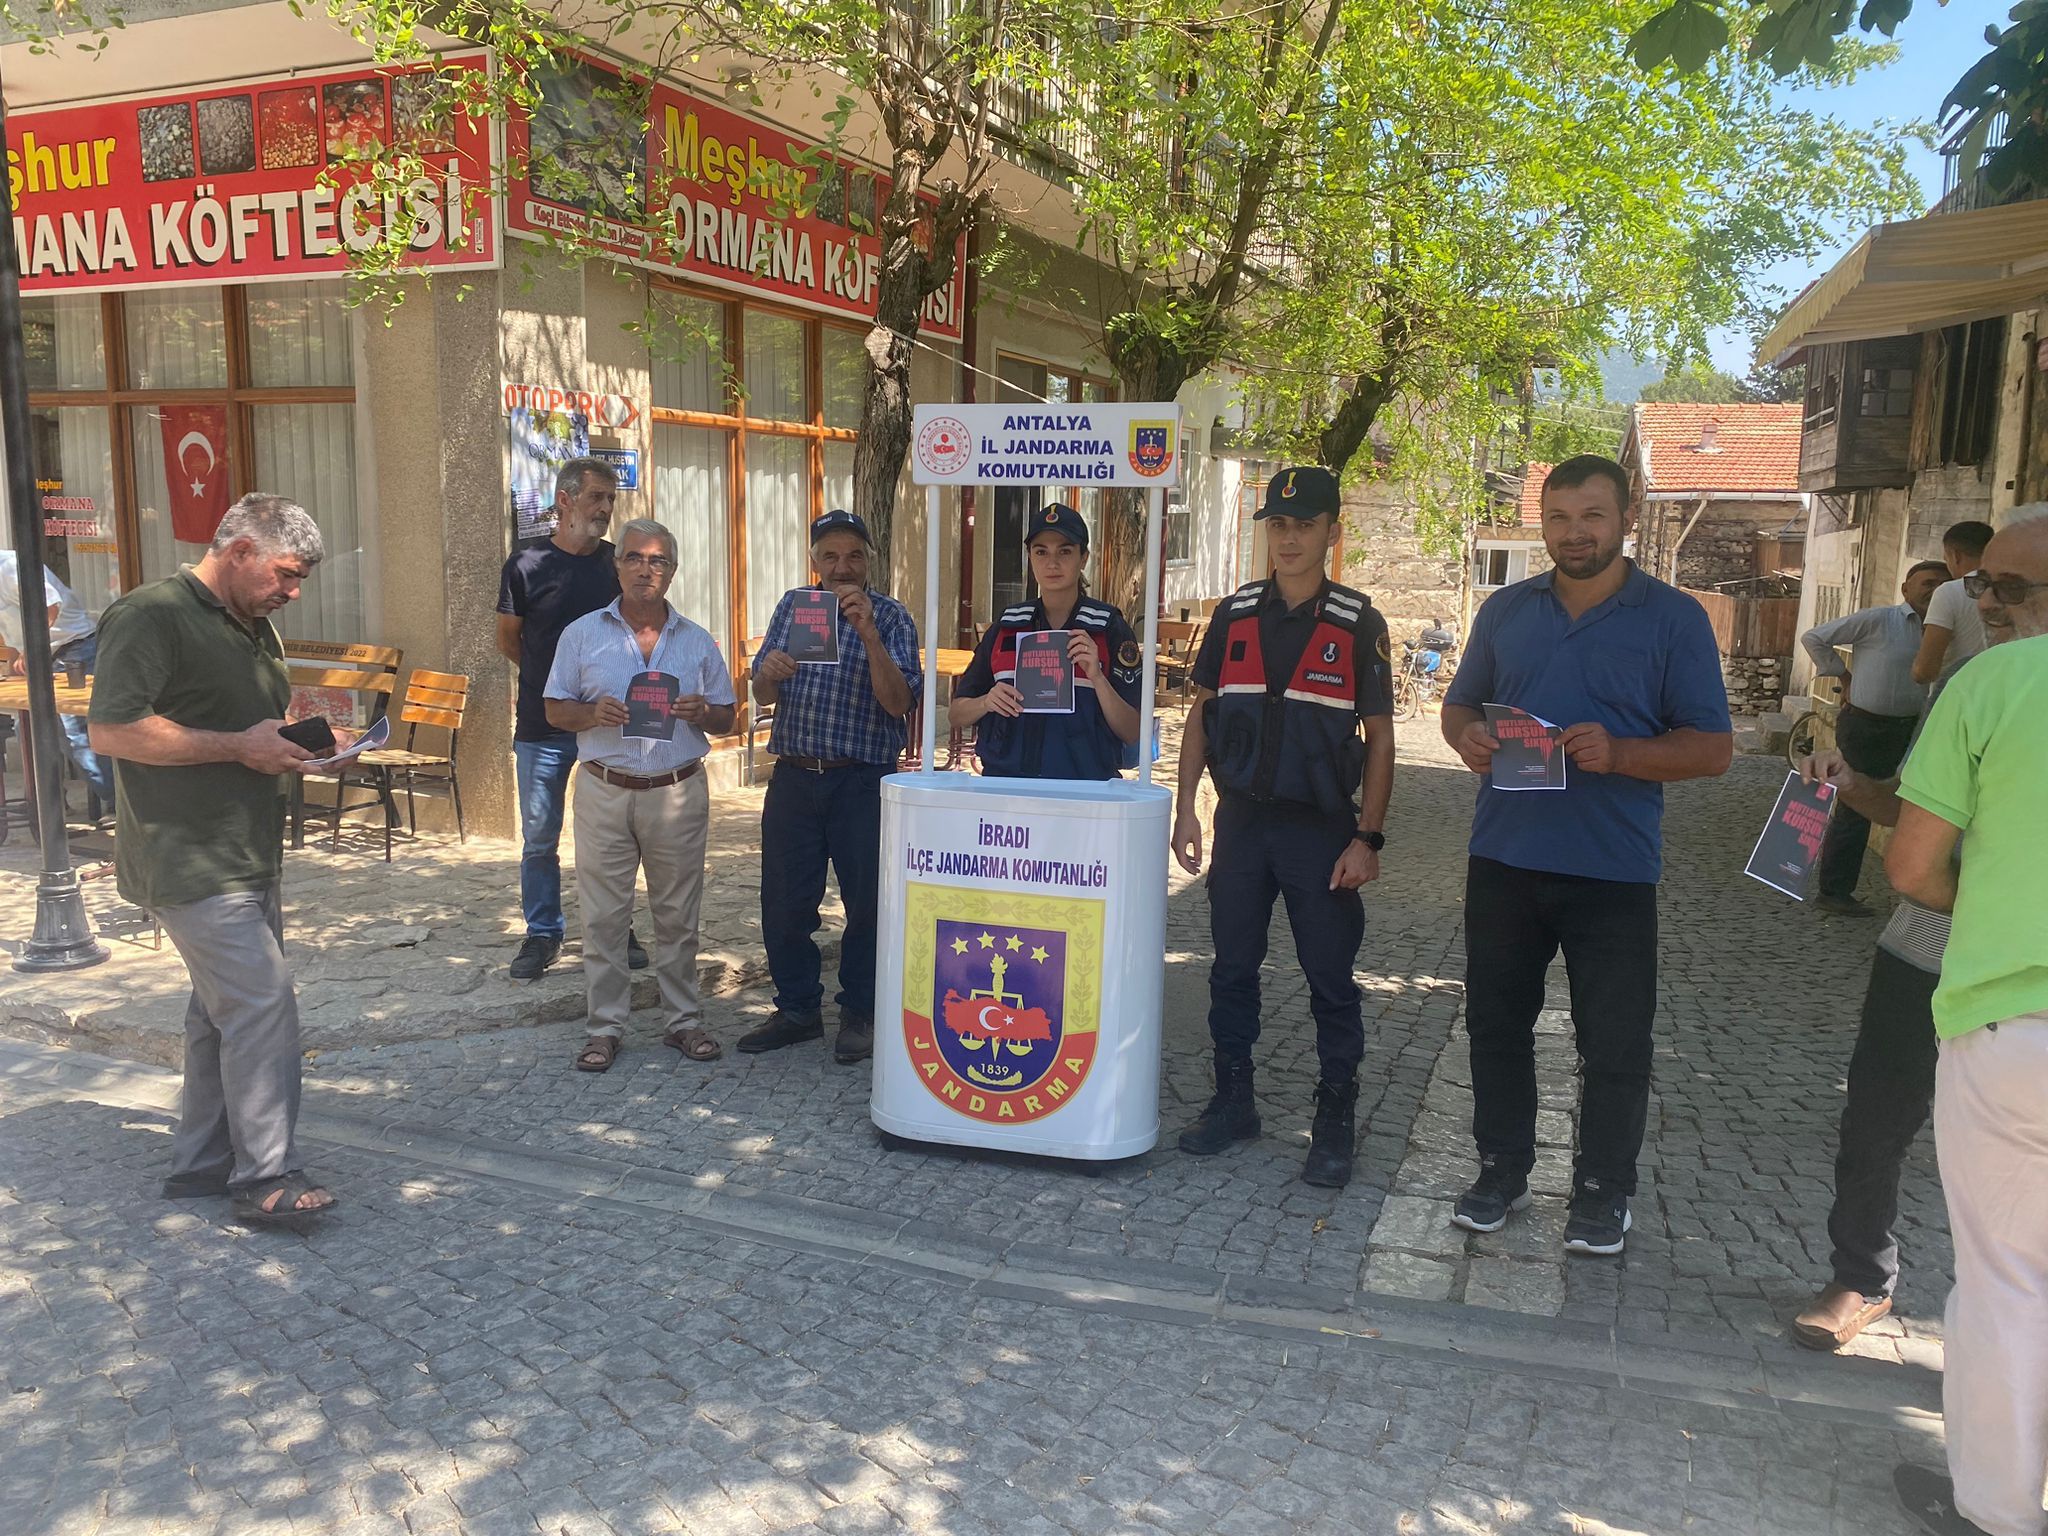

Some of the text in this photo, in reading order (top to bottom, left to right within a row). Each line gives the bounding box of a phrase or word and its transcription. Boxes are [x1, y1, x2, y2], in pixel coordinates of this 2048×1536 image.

[668, 192, 816, 289] ORMANA
[1003, 415, 1092, 431] ANTALYA
[981, 435, 998, 454] İL
[1004, 440, 1114, 455] JANDARMA
[978, 460, 1115, 480] KOMUTANLIĞI
[42, 496, 95, 510] ORMANA
[350, 648, 367, 657] 2022
[1306, 672, 1344, 685] JANDARMA
[978, 818, 1030, 850] İBRADI
[906, 841, 1108, 888] İLÇE JANDARMA KOMUTANLIĞI
[913, 1035, 1085, 1118] JANDARMA
[980, 1062, 1010, 1076] 1839
